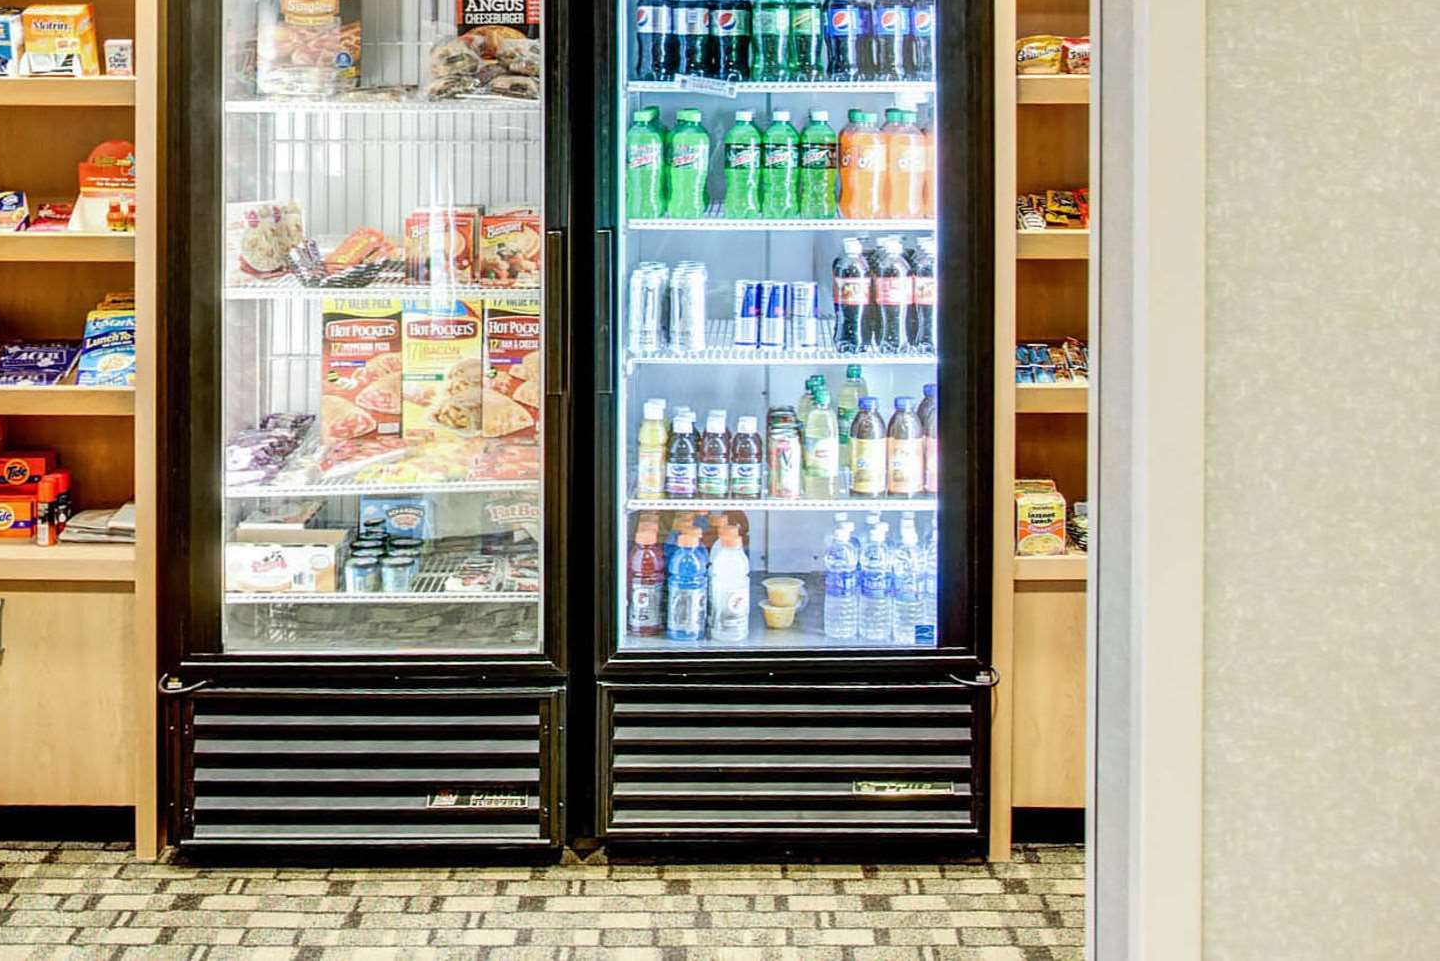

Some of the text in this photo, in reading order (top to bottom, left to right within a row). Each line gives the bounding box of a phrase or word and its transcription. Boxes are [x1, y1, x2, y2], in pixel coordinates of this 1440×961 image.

[464, 12, 525, 25] CHEESEBURGER
[431, 323, 475, 337] POCKETS
[488, 321, 509, 335] HOT
[86, 334, 119, 348] Lunch
[7, 465, 27, 479] Tide
